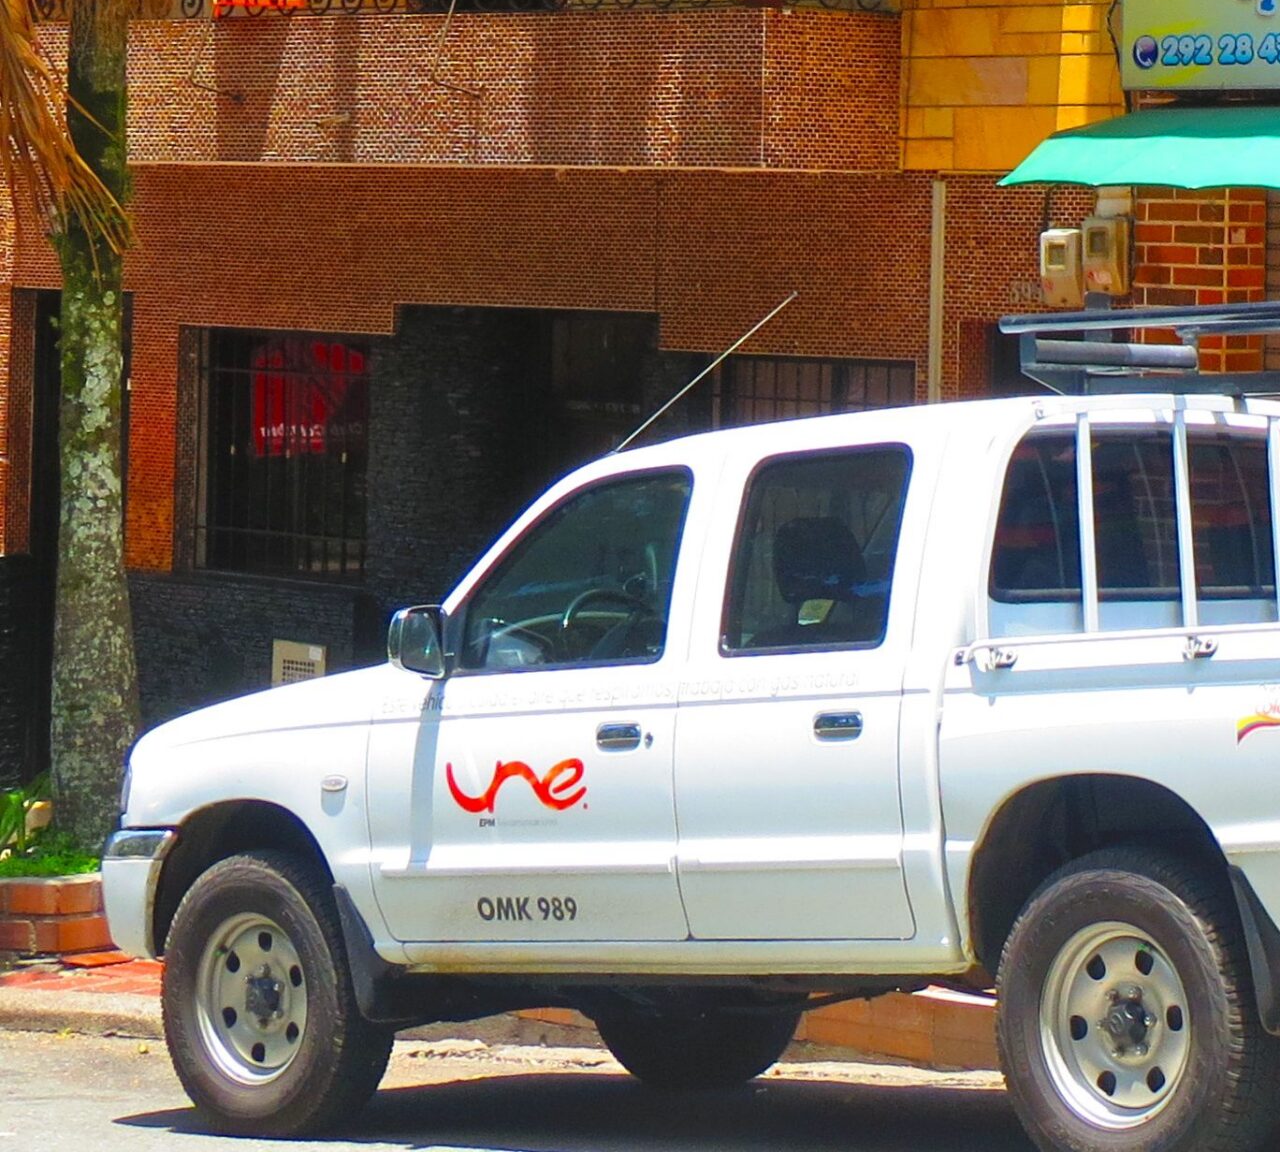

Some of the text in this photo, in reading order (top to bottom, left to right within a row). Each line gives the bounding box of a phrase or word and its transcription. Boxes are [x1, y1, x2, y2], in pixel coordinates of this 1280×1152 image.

[1161, 35, 1213, 65] 292
[1218, 33, 1254, 65] 28
[477, 896, 577, 921] OMK 989
